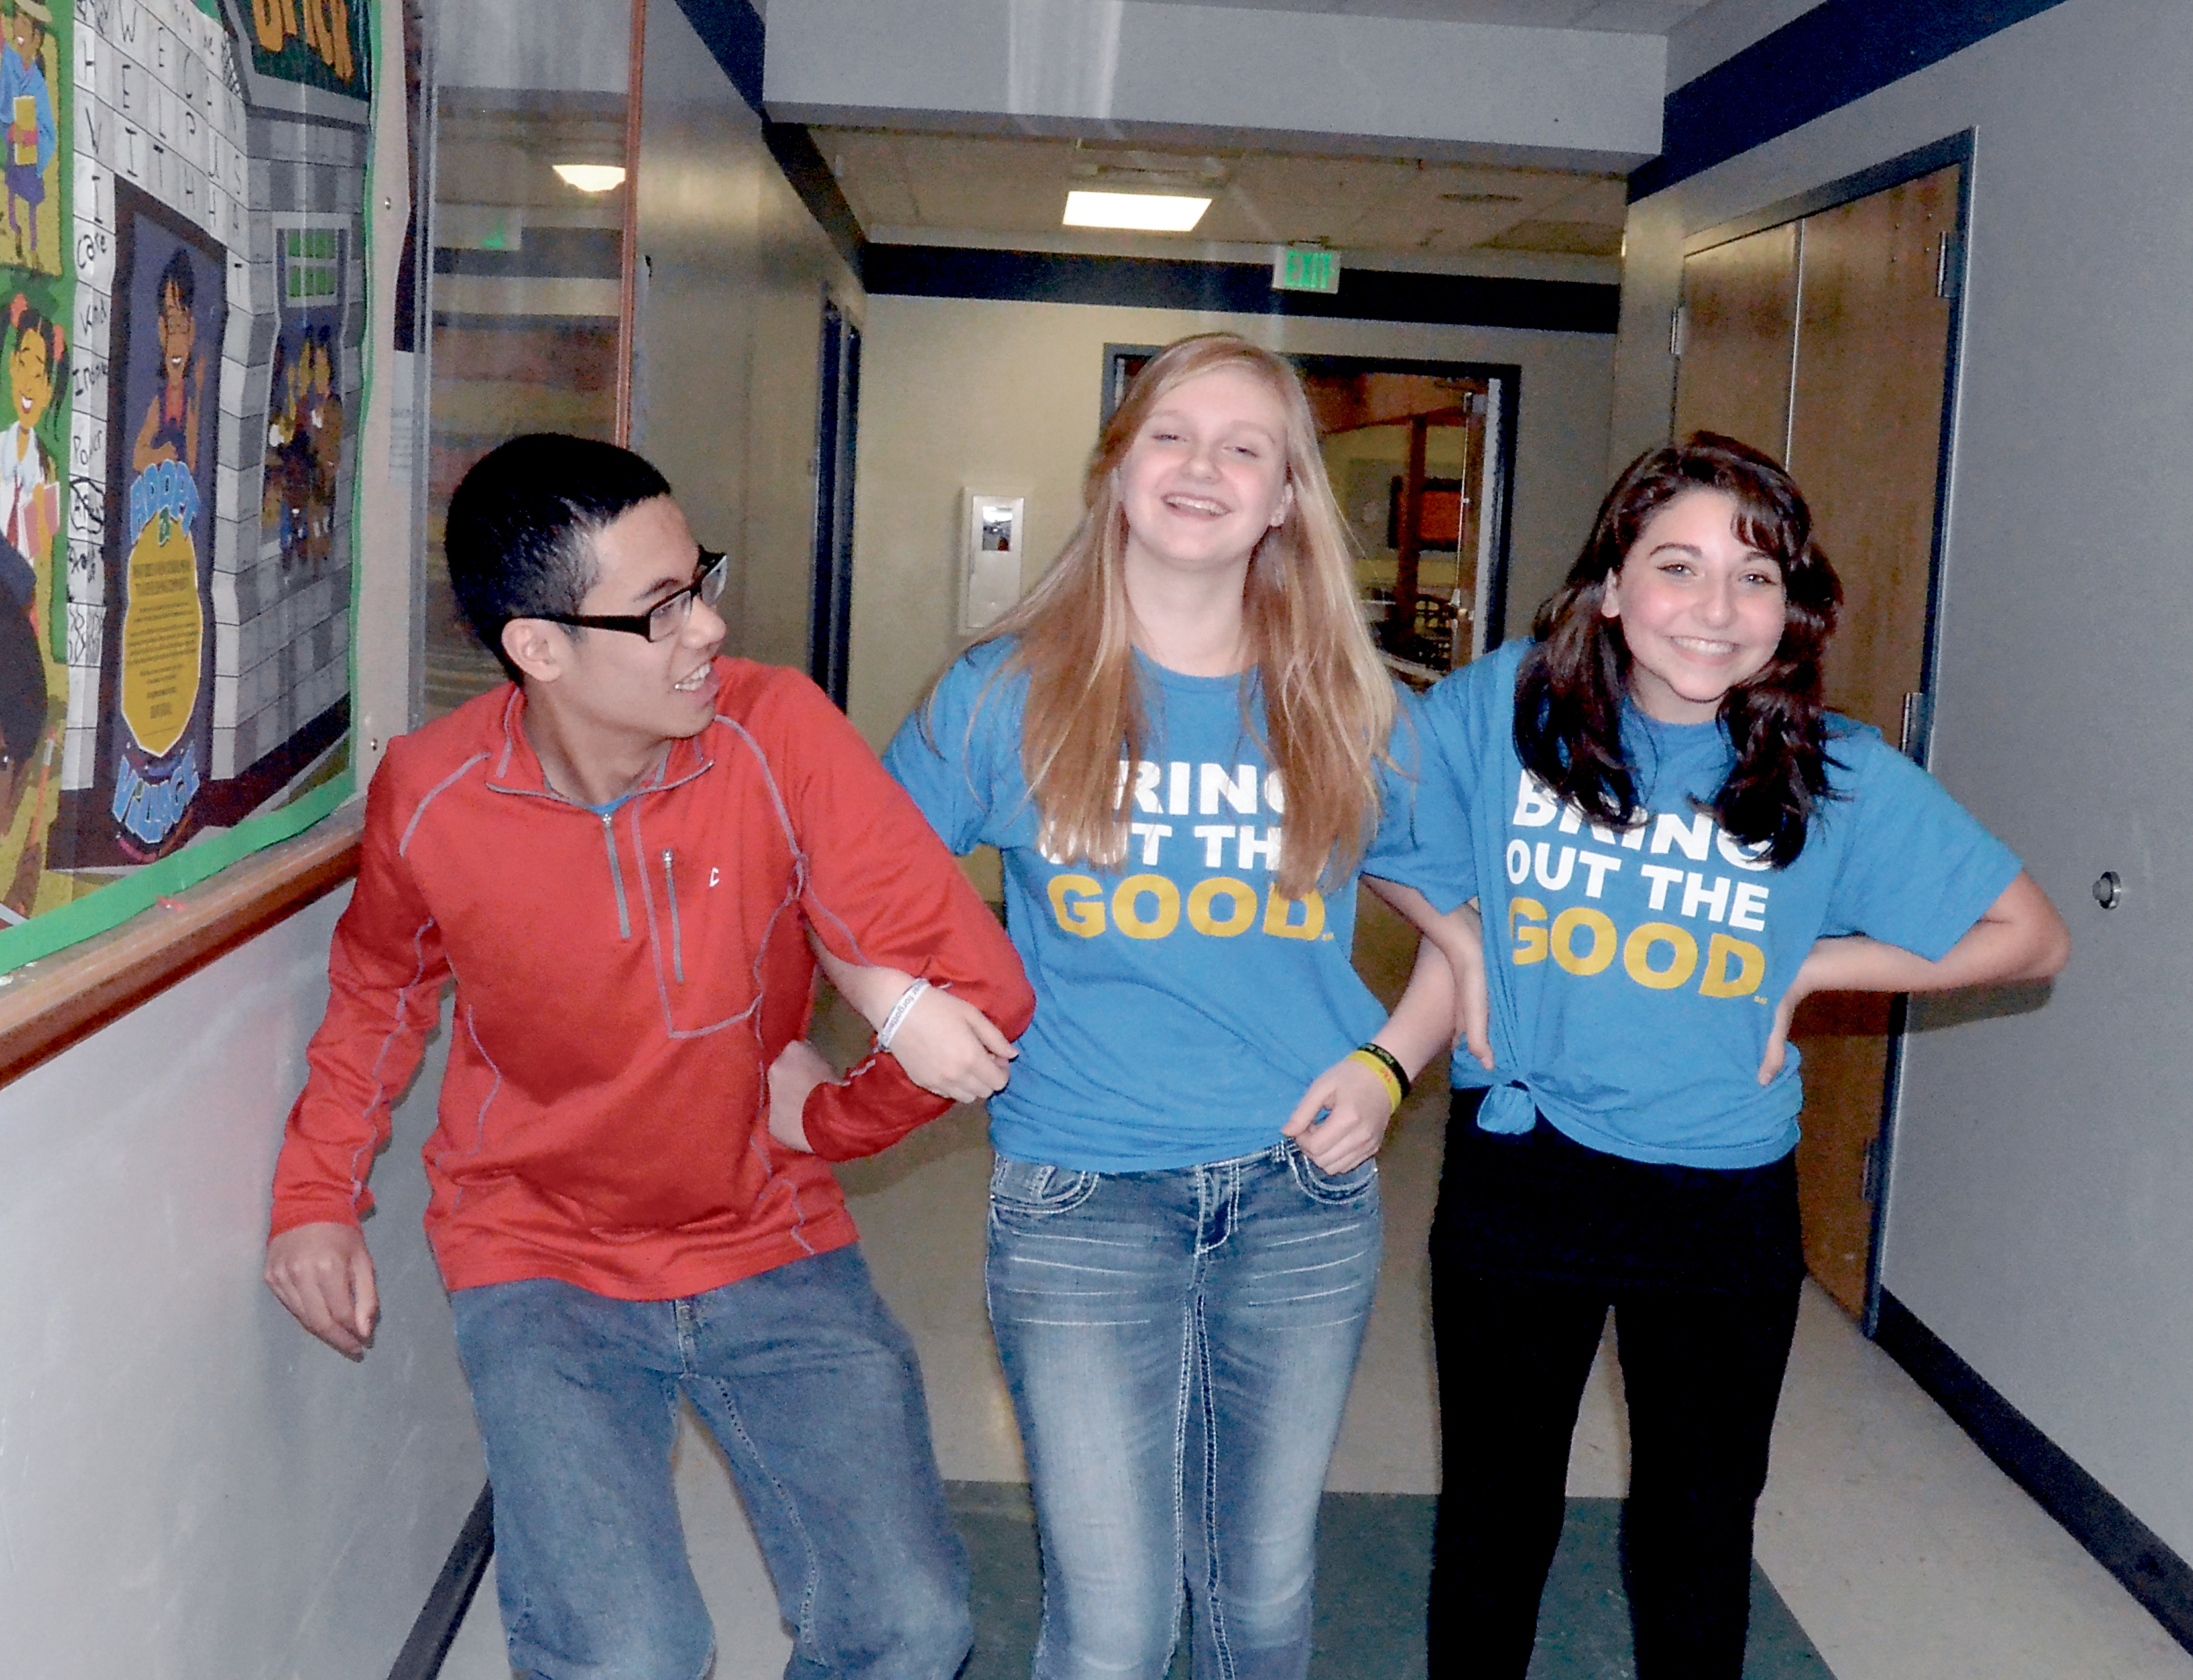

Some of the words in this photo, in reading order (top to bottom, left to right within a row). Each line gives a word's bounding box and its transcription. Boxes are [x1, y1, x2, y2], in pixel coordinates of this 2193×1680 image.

[77, 232, 107, 269] Care
[1285, 251, 1332, 289] EXIT
[1113, 760, 1285, 815] RIN
[1193, 825, 1282, 870] TH
[1047, 874, 1325, 941] GOOD
[1507, 839, 1622, 898] OUT
[1641, 864, 1769, 931] THE
[1508, 896, 1765, 998] GOOD
